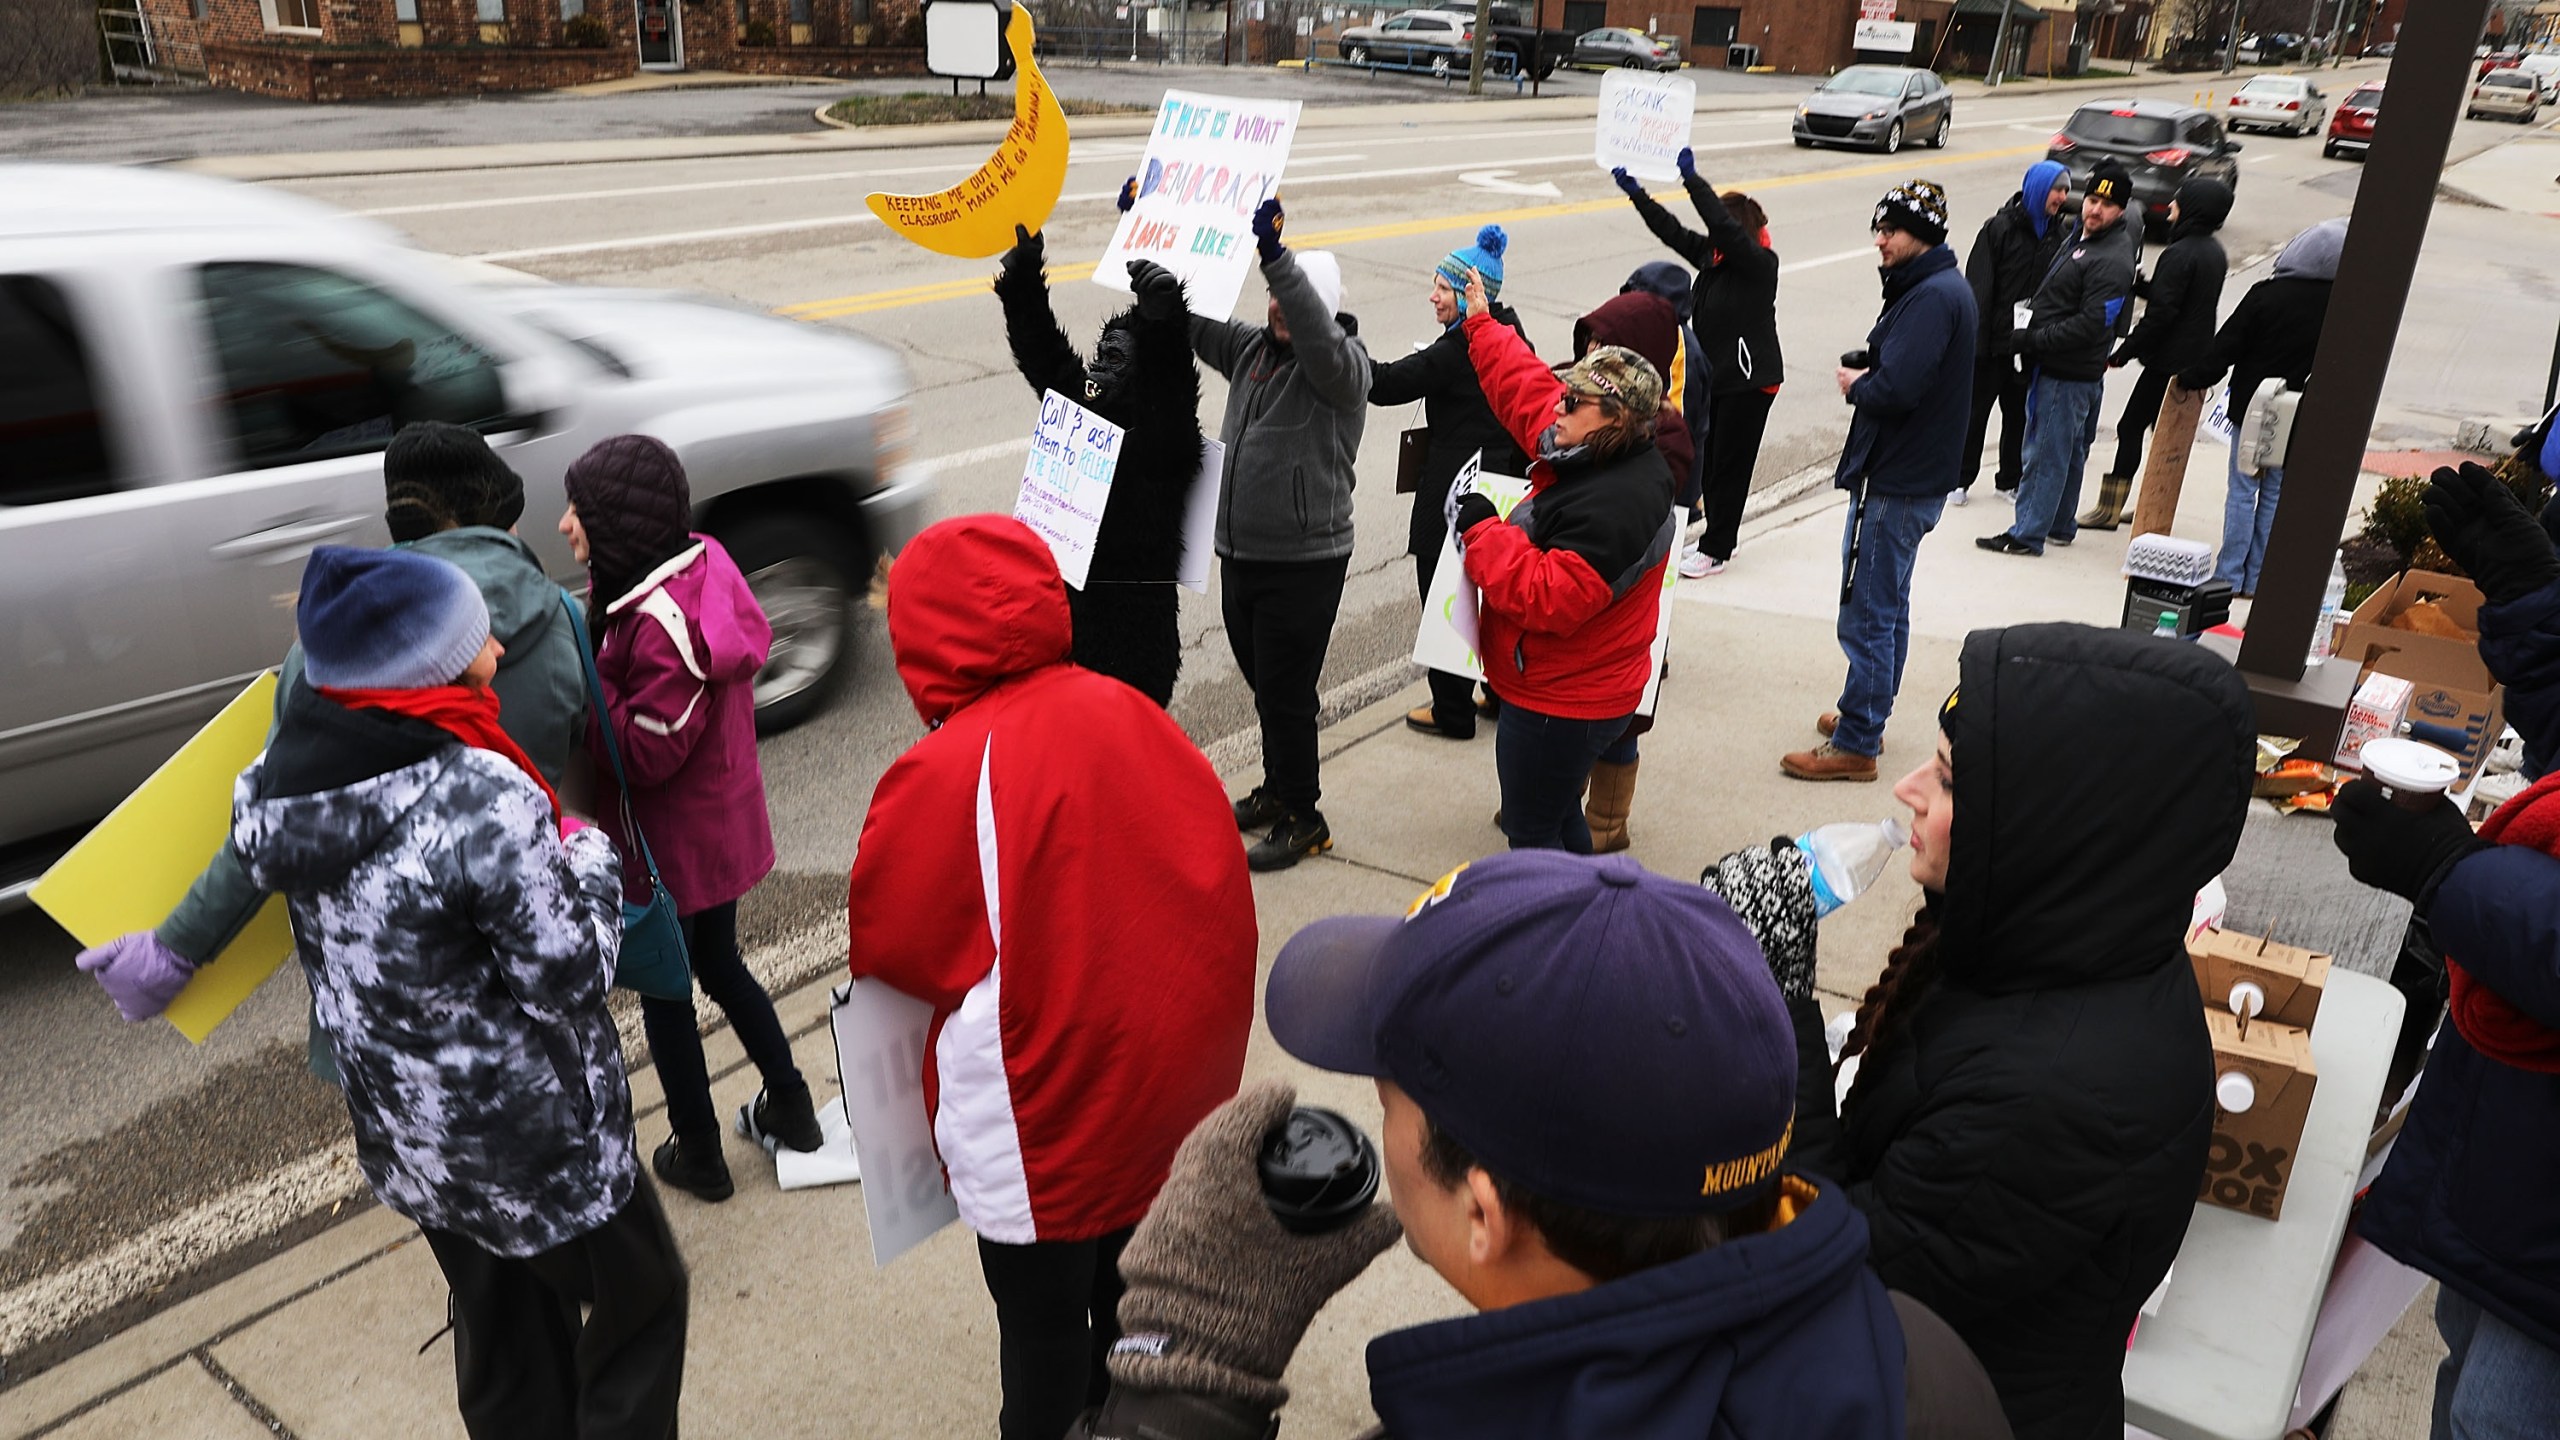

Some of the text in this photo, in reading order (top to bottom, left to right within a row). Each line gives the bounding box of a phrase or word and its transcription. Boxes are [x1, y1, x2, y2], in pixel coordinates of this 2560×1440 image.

[1160, 99, 1286, 146] THIS IS WHAT
[1623, 86, 1668, 112] HONK
[885, 115, 1026, 211] KEEPING ME OUT OF THE
[900, 208, 961, 227] CLASSROOM
[966, 183, 999, 213] MAKES
[999, 165, 1017, 186] ME
[1014, 148, 1028, 165] GO
[1139, 156, 1276, 217] DEMOCRACY
[1122, 213, 1244, 262] LOOKS LIKE!
[1588, 370, 1620, 394] HOYT
[1041, 395, 1069, 430] Call
[1087, 425, 1115, 453] ask
[2208, 404, 2230, 429] For
[1029, 448, 1046, 477] THE
[1034, 423, 1117, 485] them to RELEASE
[2205, 1132, 2288, 1186] OX
